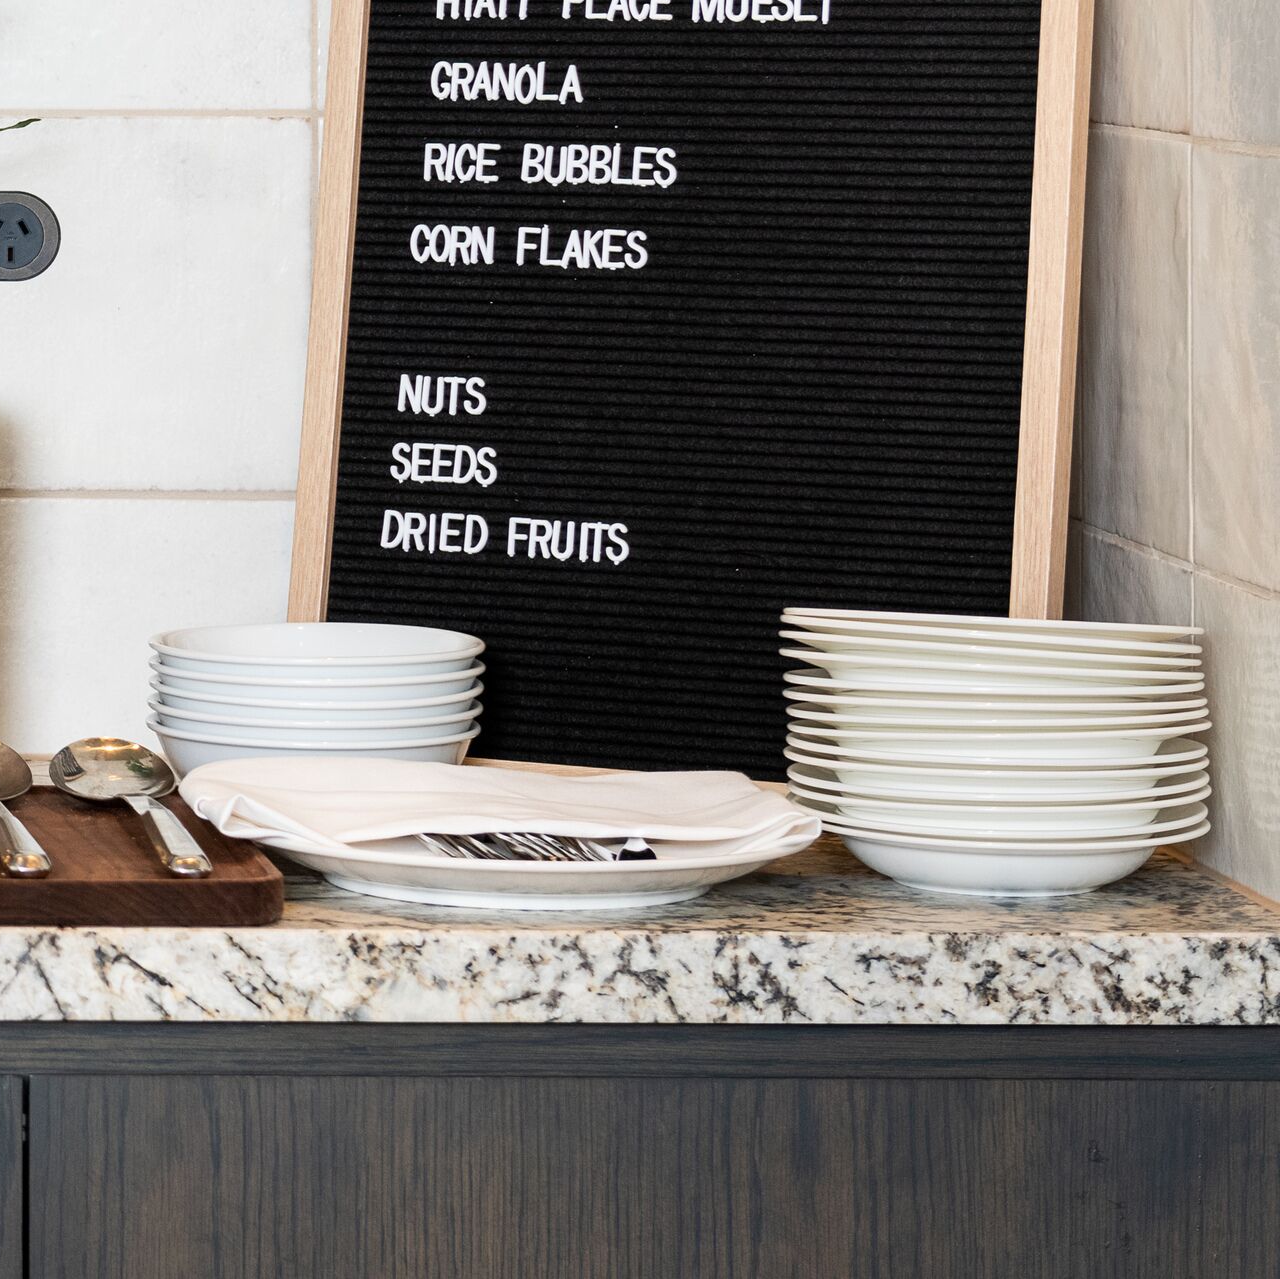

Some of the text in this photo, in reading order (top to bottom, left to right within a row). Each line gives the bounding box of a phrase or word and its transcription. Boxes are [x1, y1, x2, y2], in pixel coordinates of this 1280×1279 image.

[431, 61, 583, 104] GRANOLA
[424, 143, 677, 188] RICE BUBBLES
[410, 224, 647, 270] CORN FLAKES
[398, 374, 486, 417] NUTS
[390, 443, 497, 487] SEEDS
[381, 510, 629, 565] DRIED FRUITS
